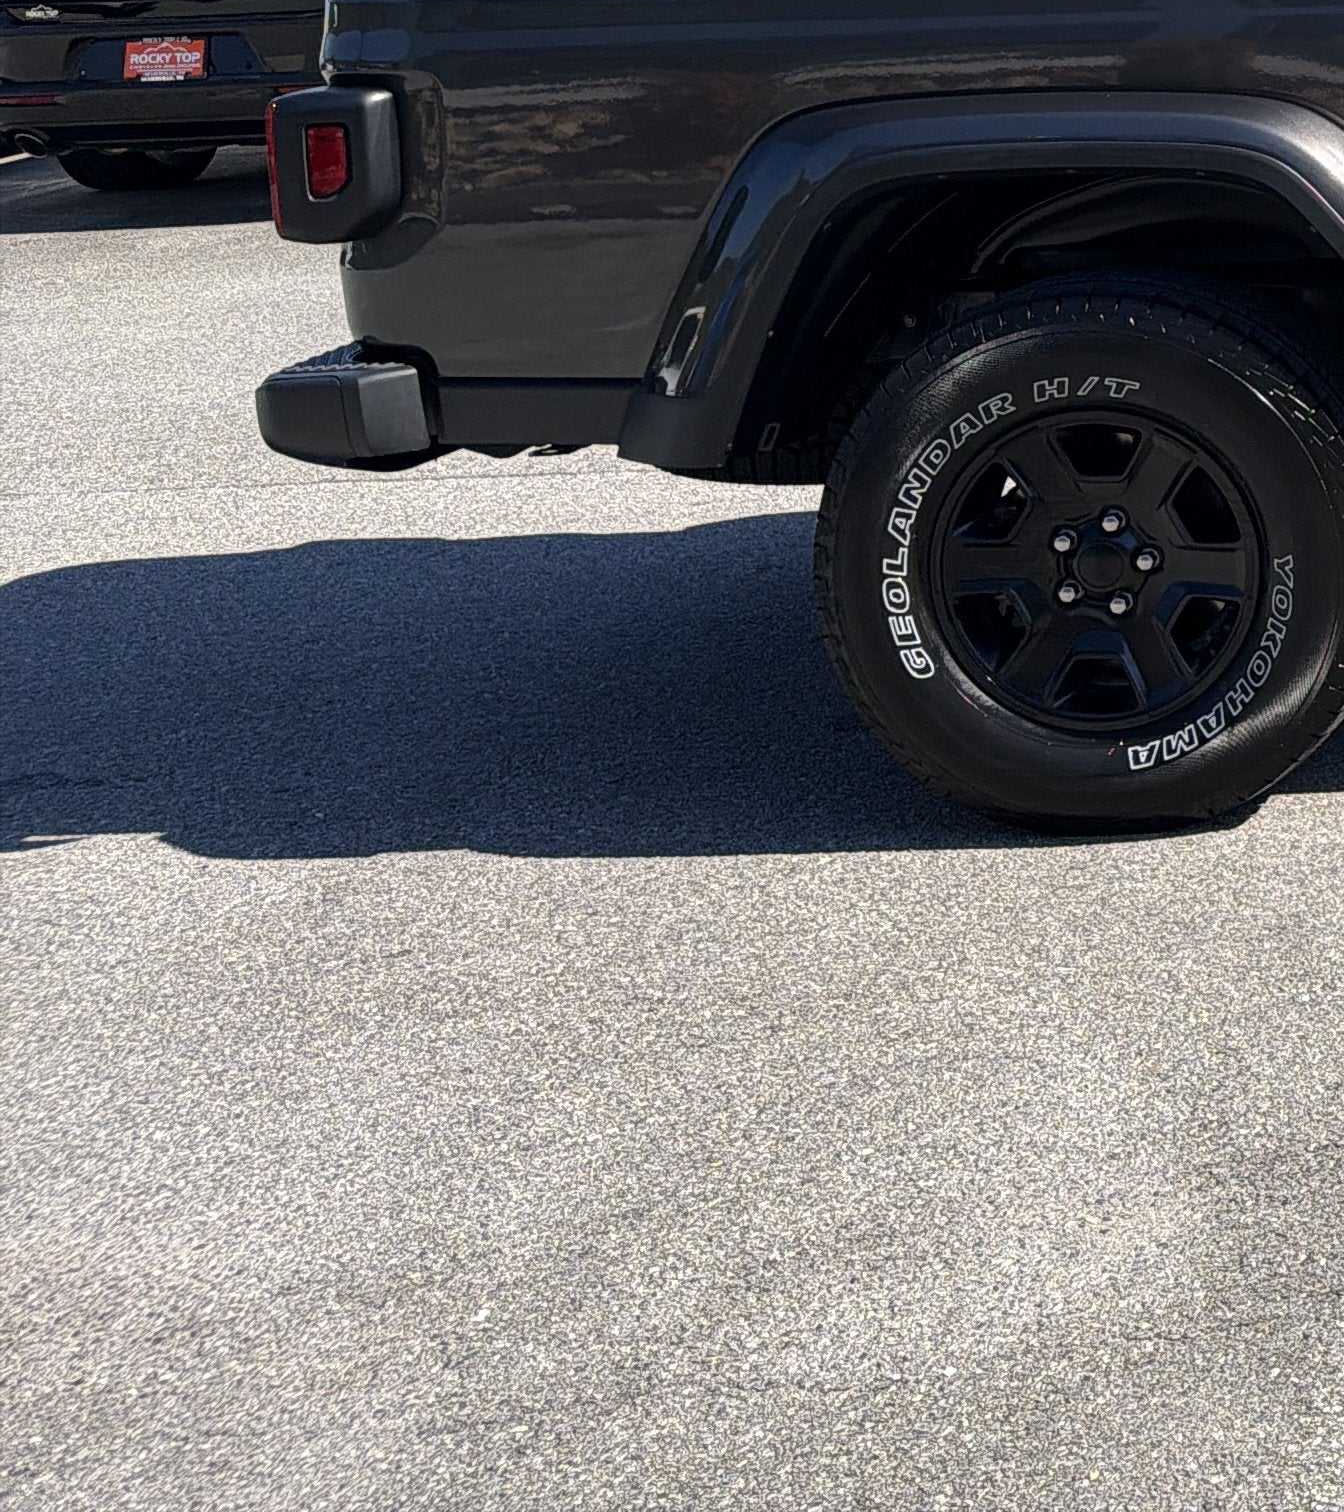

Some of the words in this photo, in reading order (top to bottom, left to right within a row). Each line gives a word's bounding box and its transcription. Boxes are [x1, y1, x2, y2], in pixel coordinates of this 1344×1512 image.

[129, 53, 173, 65] ROCKY
[174, 52, 201, 64] TOP
[882, 392, 1016, 679] GEOLANDAR
[1033, 376, 1140, 402] H/T
[1127, 554, 1294, 771] YOKOHAMA
